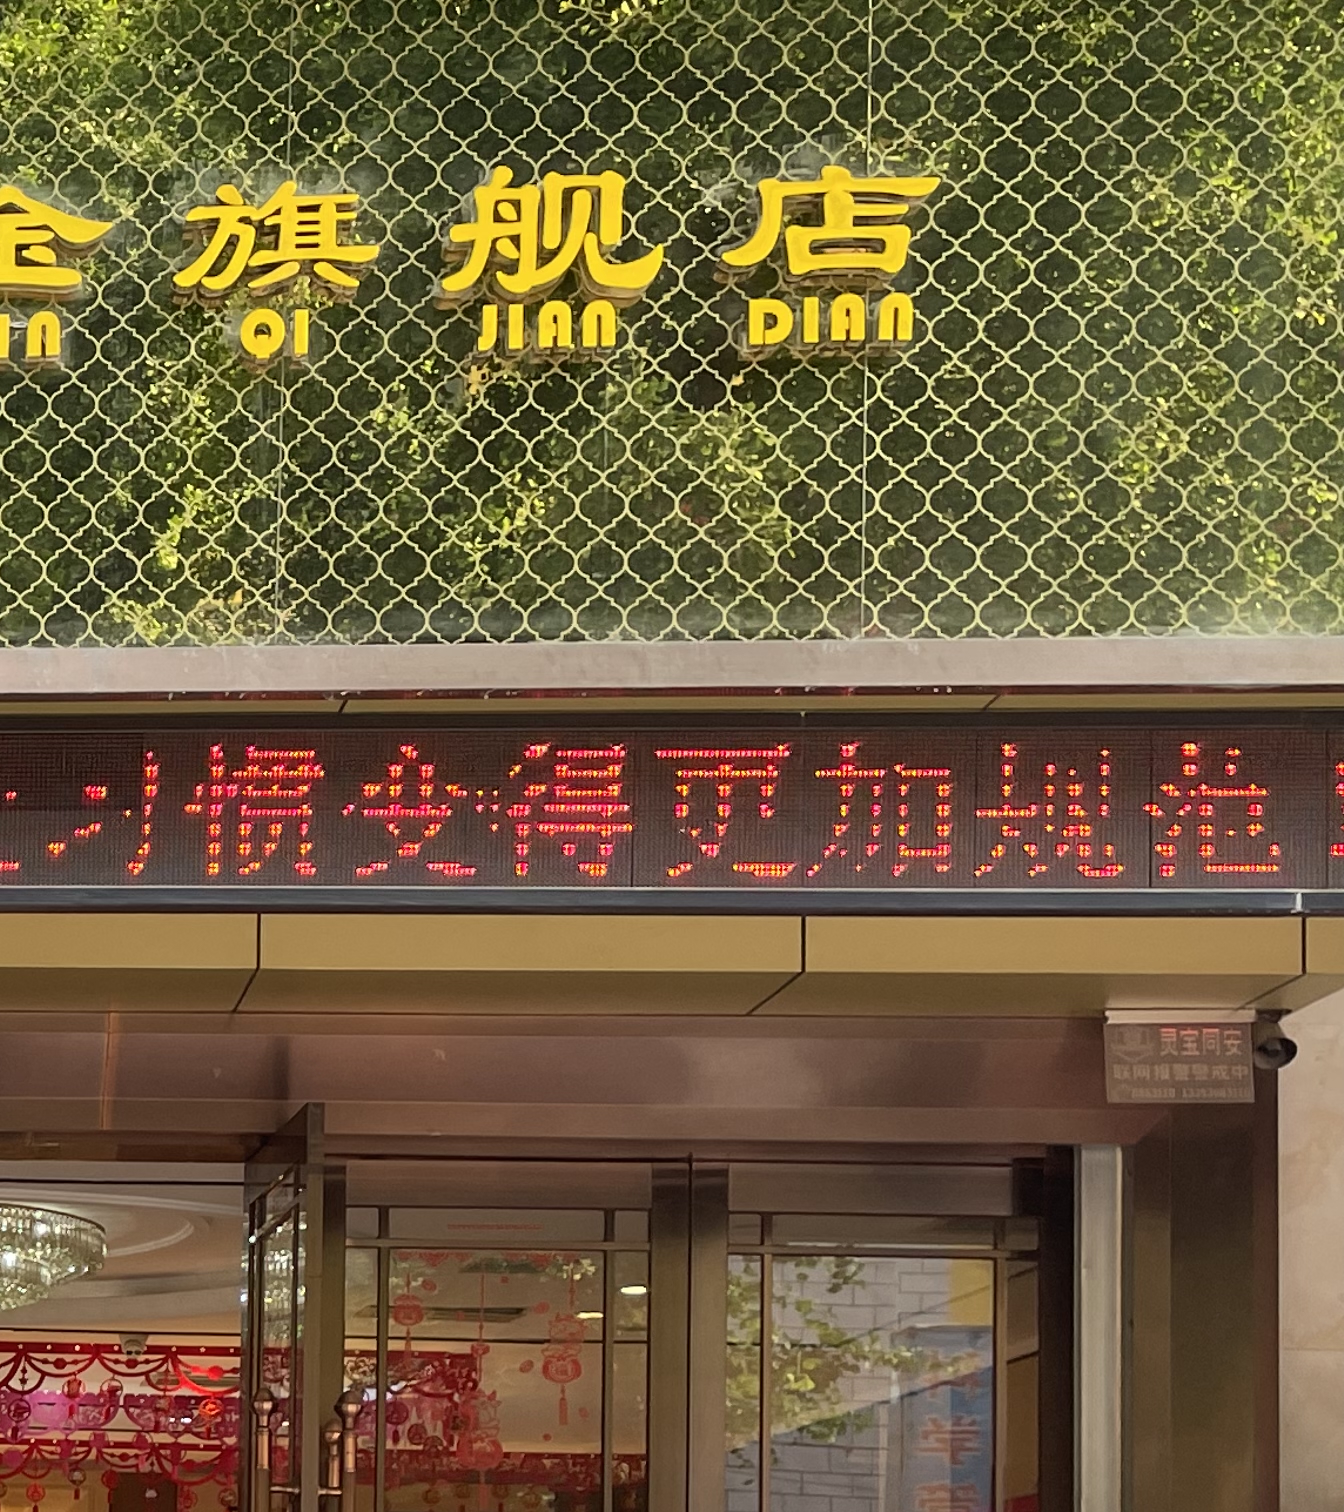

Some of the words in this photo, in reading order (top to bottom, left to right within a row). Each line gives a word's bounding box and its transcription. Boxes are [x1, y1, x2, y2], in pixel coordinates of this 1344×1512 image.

[240, 308, 309, 360] QI
[477, 302, 617, 351] JIAN
[749, 292, 914, 345] DIAN
